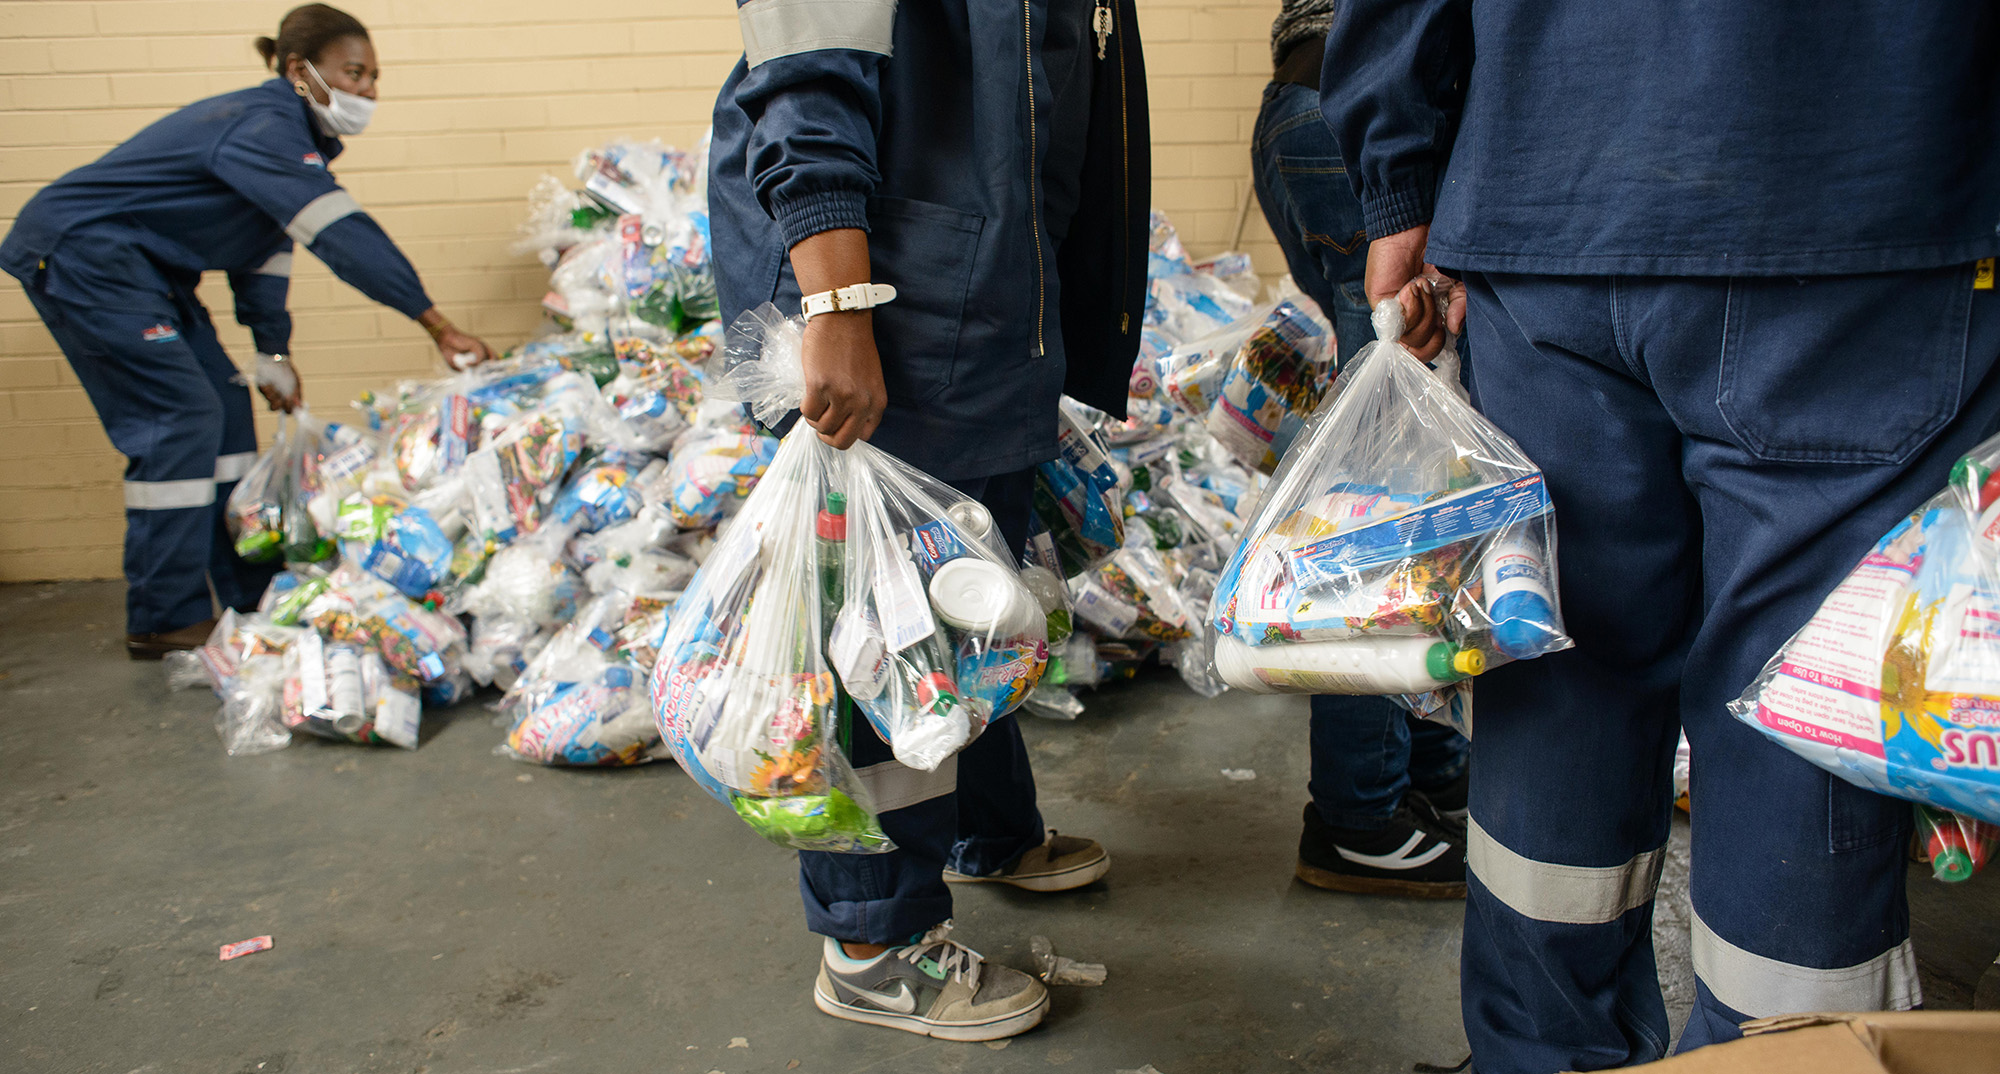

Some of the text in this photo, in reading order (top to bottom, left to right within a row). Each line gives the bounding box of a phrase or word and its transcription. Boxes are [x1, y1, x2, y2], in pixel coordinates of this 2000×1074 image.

[921, 531, 939, 558] Colgate
[1792, 666, 1844, 688] How To Use
[1801, 697, 1813, 706] peg
[1819, 704, 1833, 713] Use
[1813, 710, 1830, 720] open
[1776, 716, 1843, 744] How To Open
[1943, 732, 2000, 767] US
